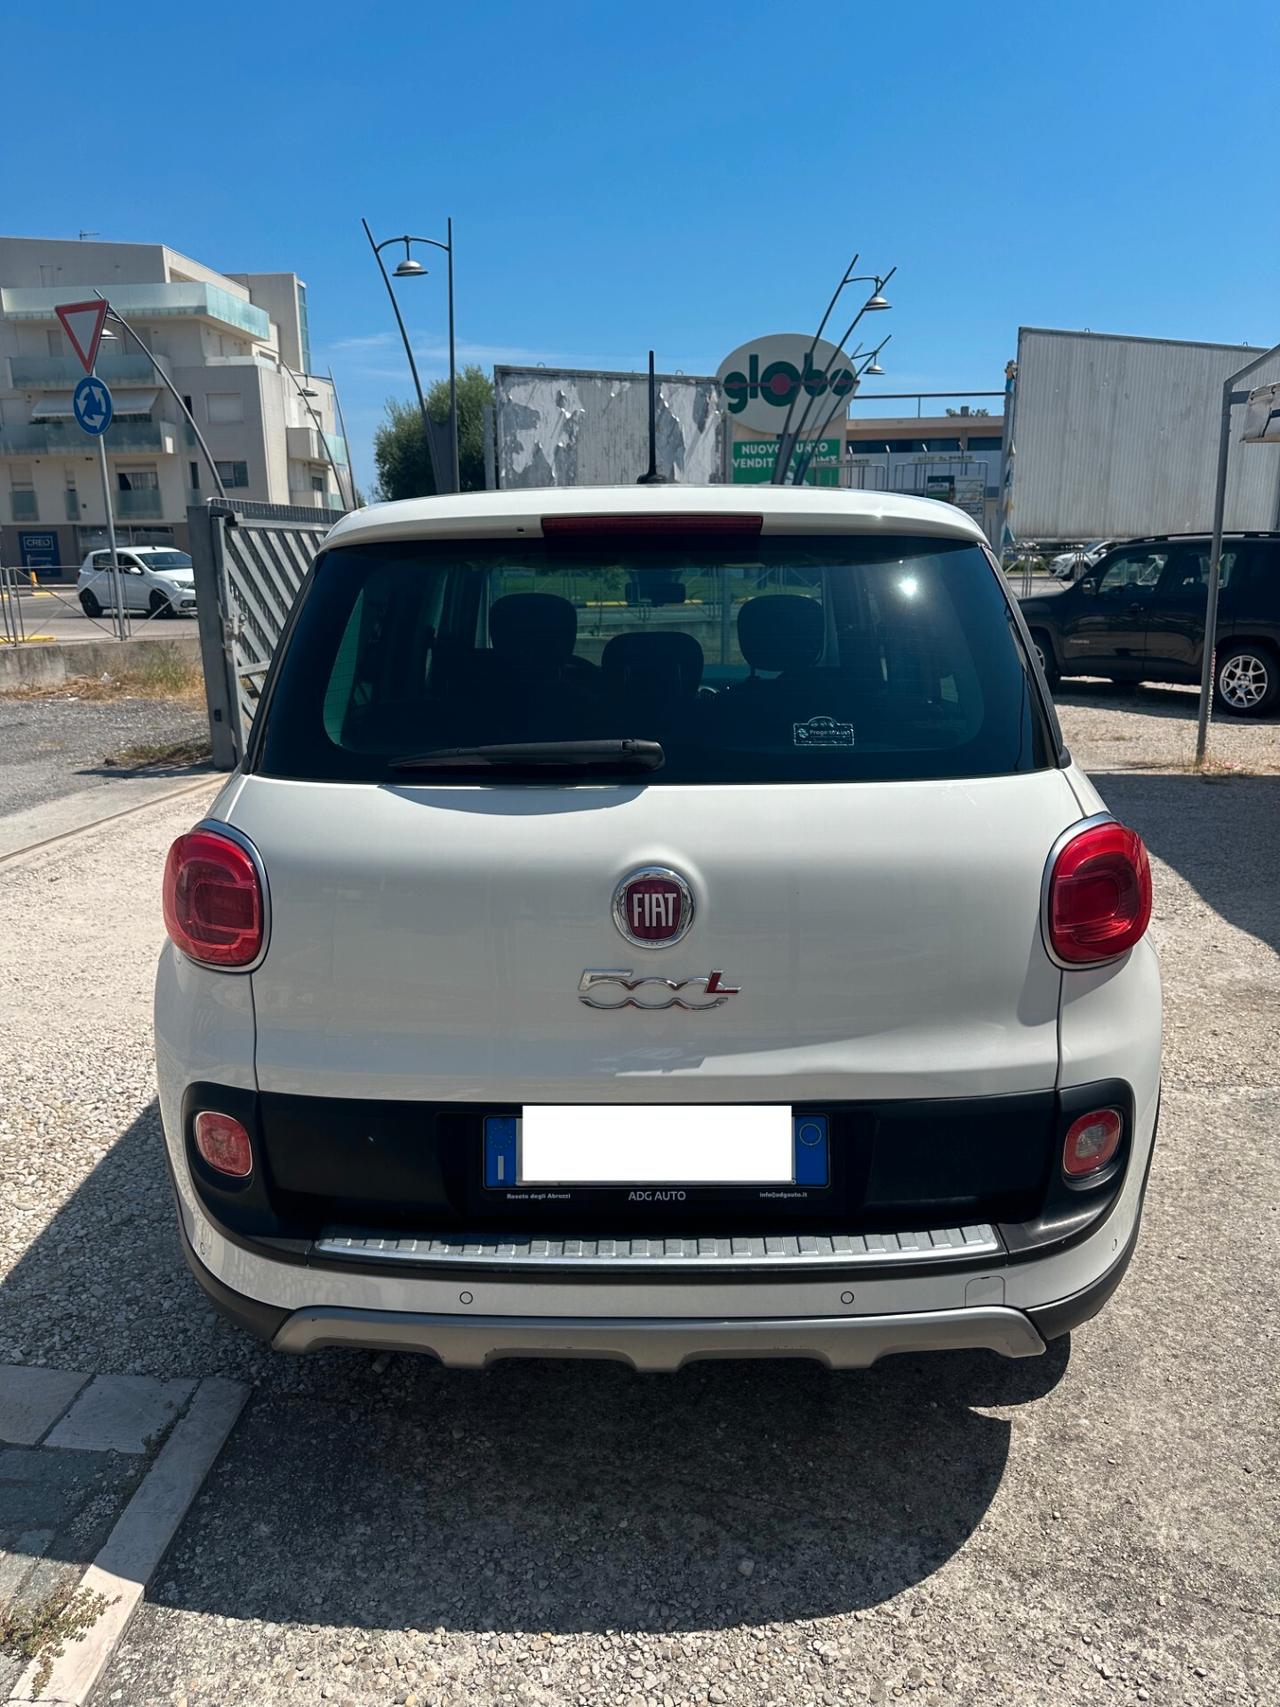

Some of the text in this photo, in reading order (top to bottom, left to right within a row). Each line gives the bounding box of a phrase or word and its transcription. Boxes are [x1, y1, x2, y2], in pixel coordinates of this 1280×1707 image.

[723, 352, 854, 414] globo
[732, 457, 775, 468] VENDIT
[633, 893, 677, 927] FIAT
[628, 1191, 687, 1202] ADG AUTO
